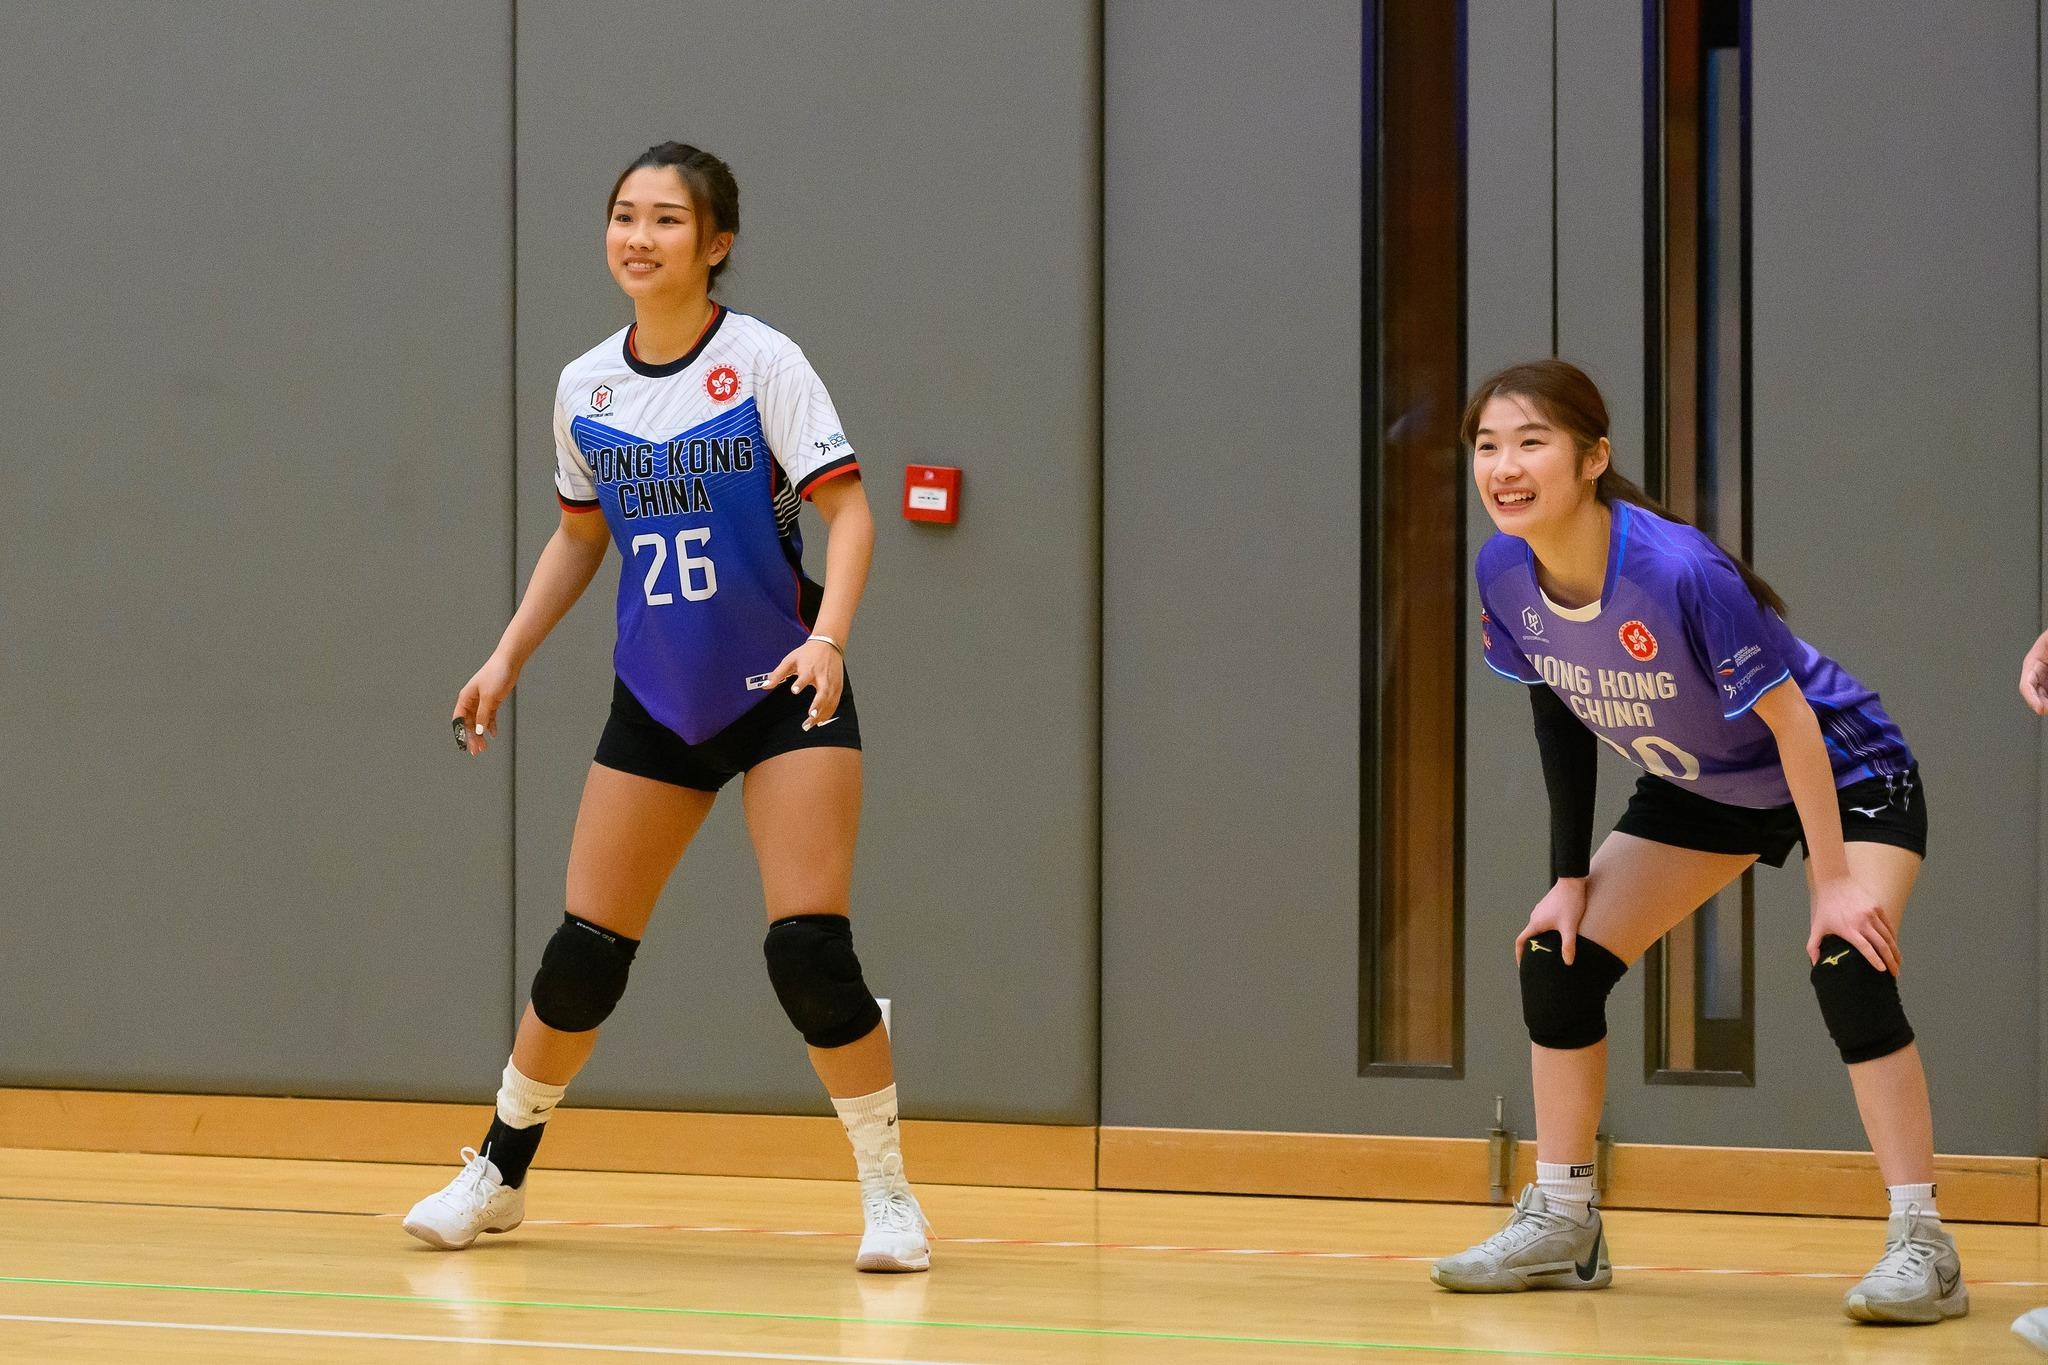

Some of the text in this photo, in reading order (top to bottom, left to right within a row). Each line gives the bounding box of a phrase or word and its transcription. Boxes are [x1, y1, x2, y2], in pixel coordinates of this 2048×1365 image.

[587, 436, 754, 484] HONG KONG
[617, 477, 713, 520] CHINA
[631, 527, 718, 606] 26
[1598, 668, 1678, 701] KONG
[1570, 694, 1656, 728] CHINA
[1594, 730, 1700, 782] 0
